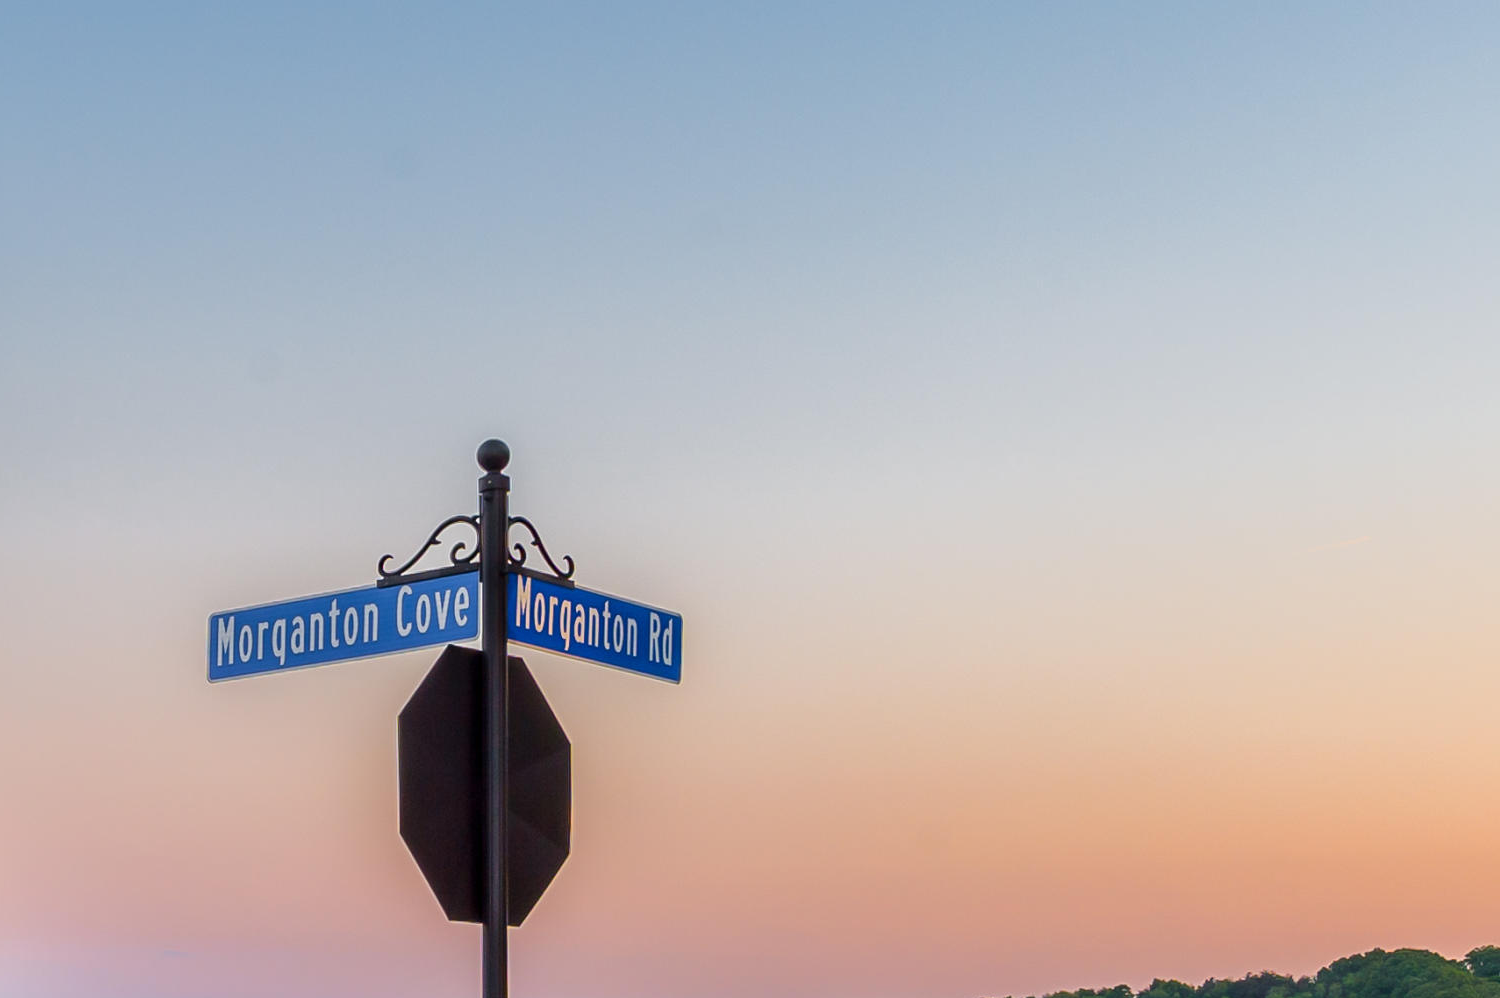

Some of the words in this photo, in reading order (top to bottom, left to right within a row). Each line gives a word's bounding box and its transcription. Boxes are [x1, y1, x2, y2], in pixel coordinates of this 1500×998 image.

[216, 597, 378, 667] Morganton
[395, 584, 470, 637] Cove
[515, 574, 638, 657] Morganton
[649, 611, 673, 666] Rd
